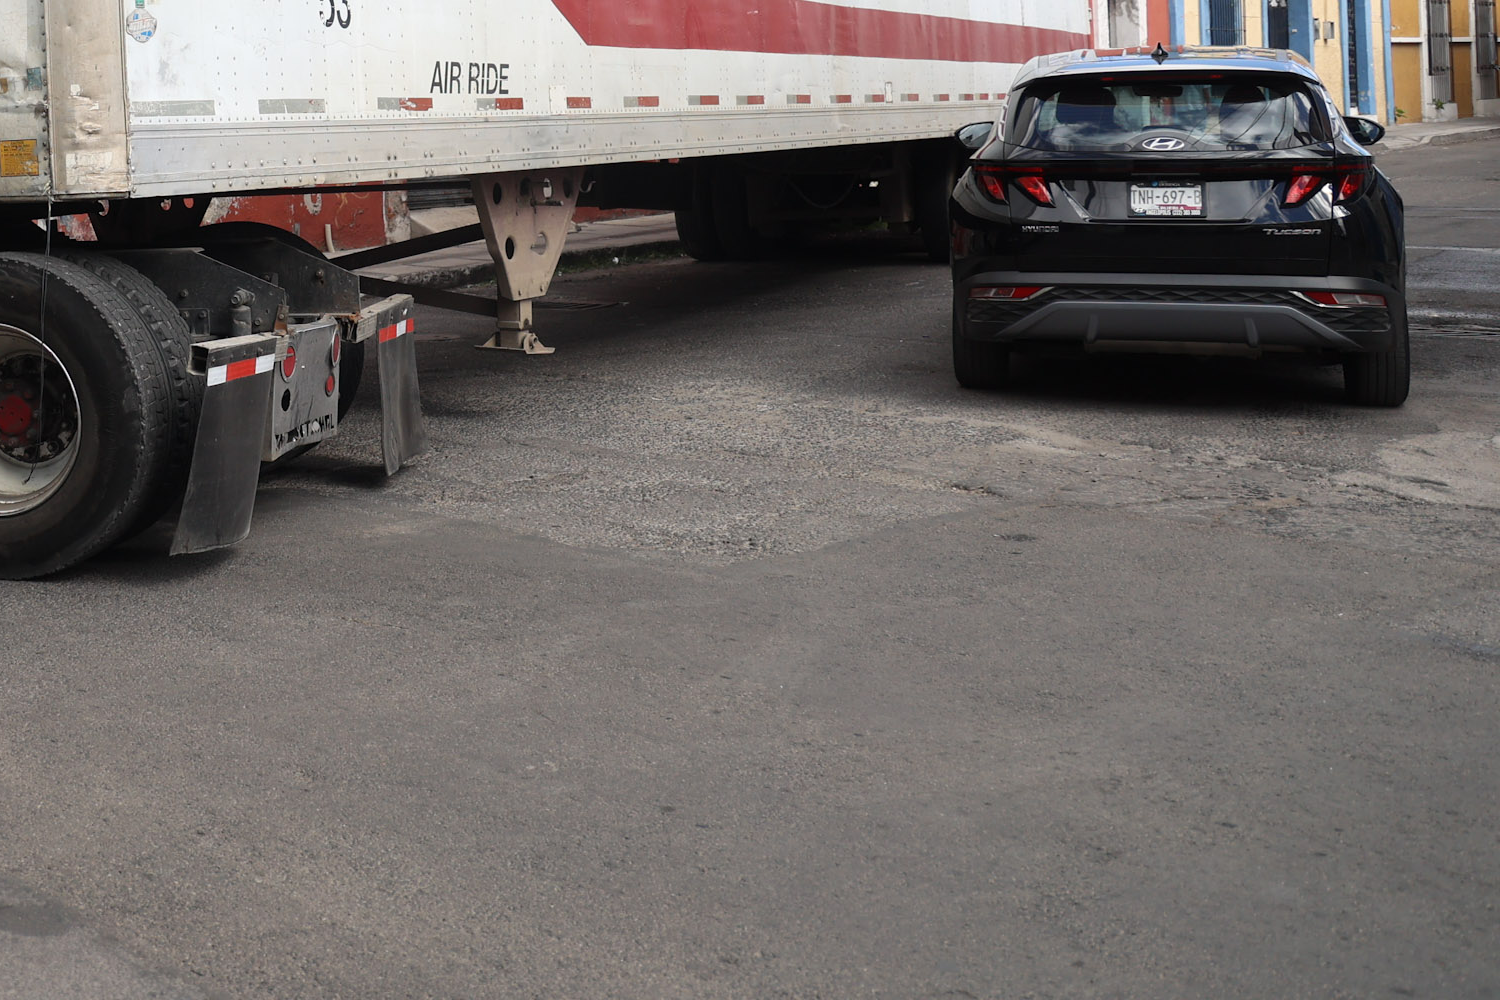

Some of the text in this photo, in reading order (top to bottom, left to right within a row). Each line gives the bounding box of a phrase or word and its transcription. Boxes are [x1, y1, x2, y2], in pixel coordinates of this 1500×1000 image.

[430, 61, 510, 95] AIR RIDE
[1021, 225, 1060, 233] HYUNDAI
